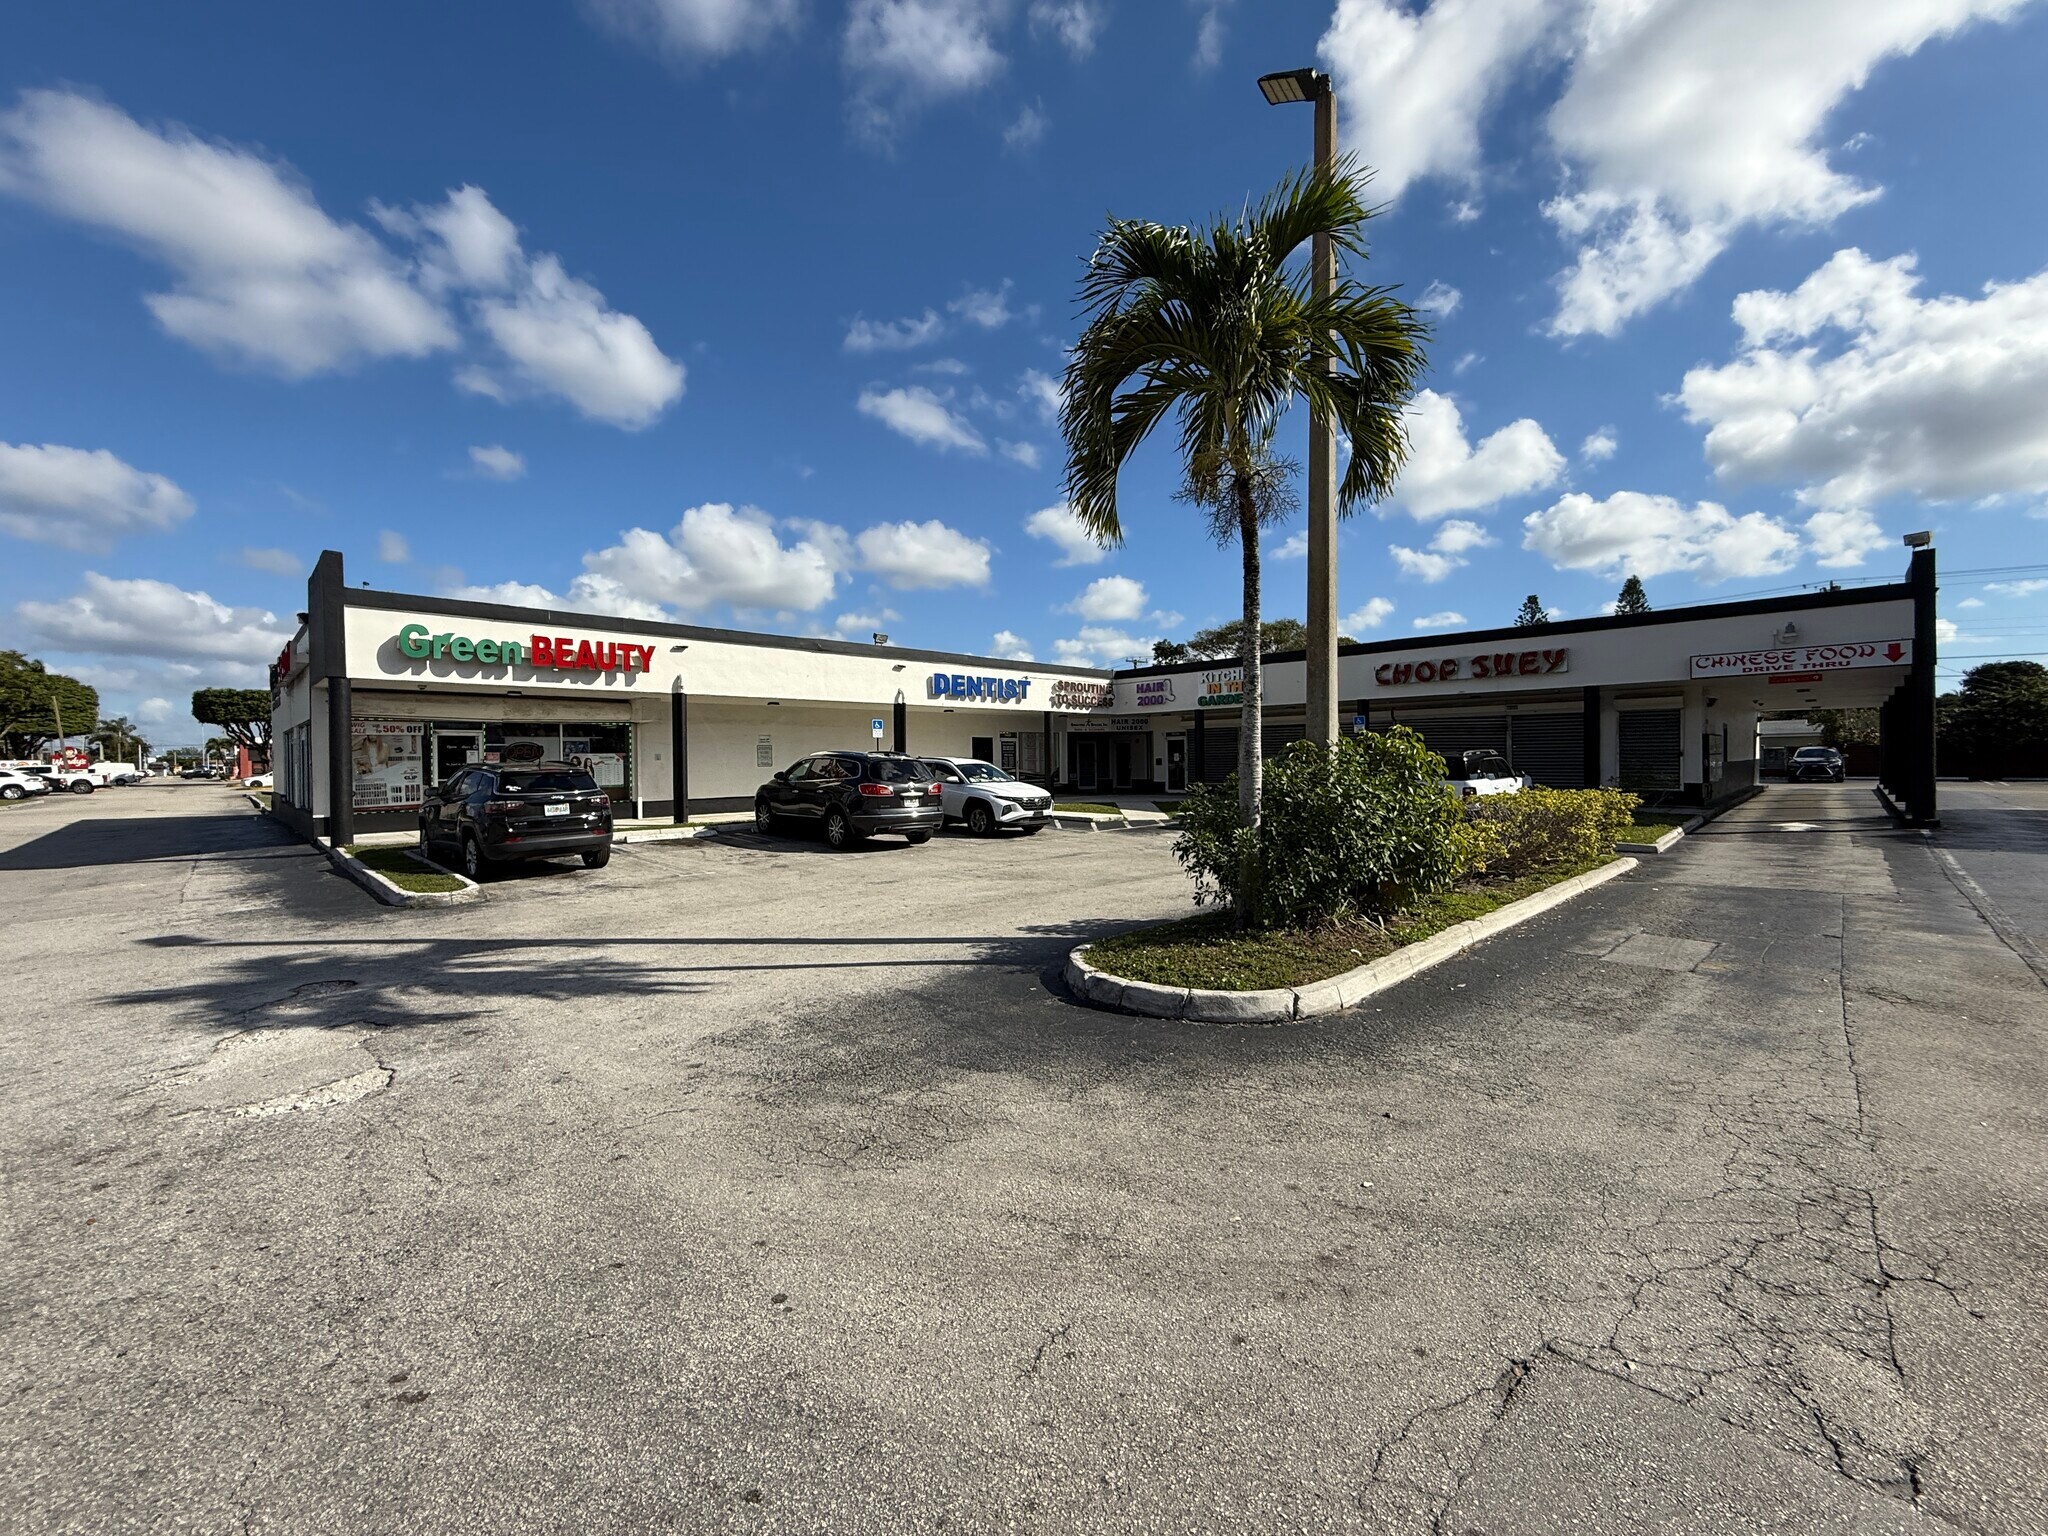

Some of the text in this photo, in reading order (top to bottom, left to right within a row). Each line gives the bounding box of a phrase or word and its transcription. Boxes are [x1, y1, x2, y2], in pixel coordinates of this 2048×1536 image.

[400, 623, 656, 673] Green BEAUTY
[1695, 644, 1876, 670] CHINESE FOOD
[1374, 648, 1567, 685] CHOP SUEY
[1742, 660, 1851, 673] DRIVE THRU
[1200, 669, 1243, 684] KITCH
[933, 673, 1031, 699] DENTIST
[1057, 680, 1113, 695] SPROUTING
[1136, 681, 1165, 693] HAIR
[1207, 681, 1244, 694] IN TH
[1056, 694, 1114, 708] TO SUCCESS
[1137, 695, 1166, 706] 2000
[1198, 694, 1262, 707] GARDE
[383, 725, 423, 733] 50% OFF
